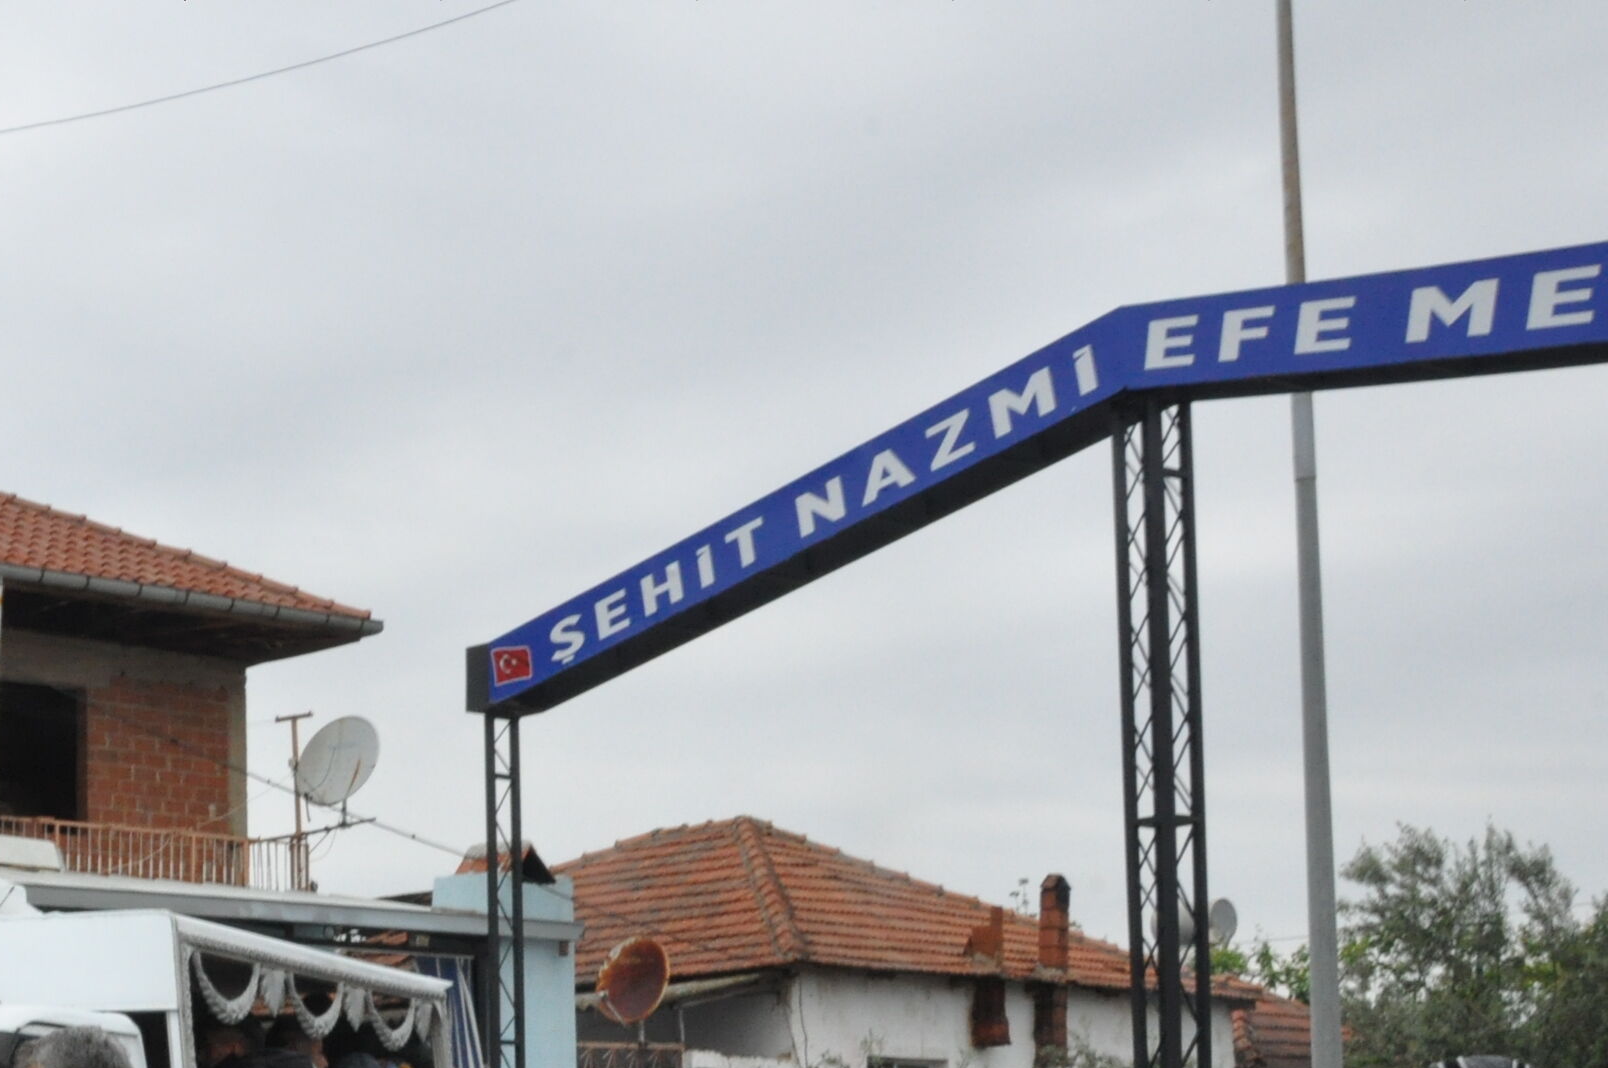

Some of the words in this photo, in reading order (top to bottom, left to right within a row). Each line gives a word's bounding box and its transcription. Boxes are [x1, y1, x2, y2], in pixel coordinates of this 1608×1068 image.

[549, 516, 763, 664] ŞEHİT
[795, 345, 1098, 538] NAZMİ
[1144, 296, 1356, 370] EFE
